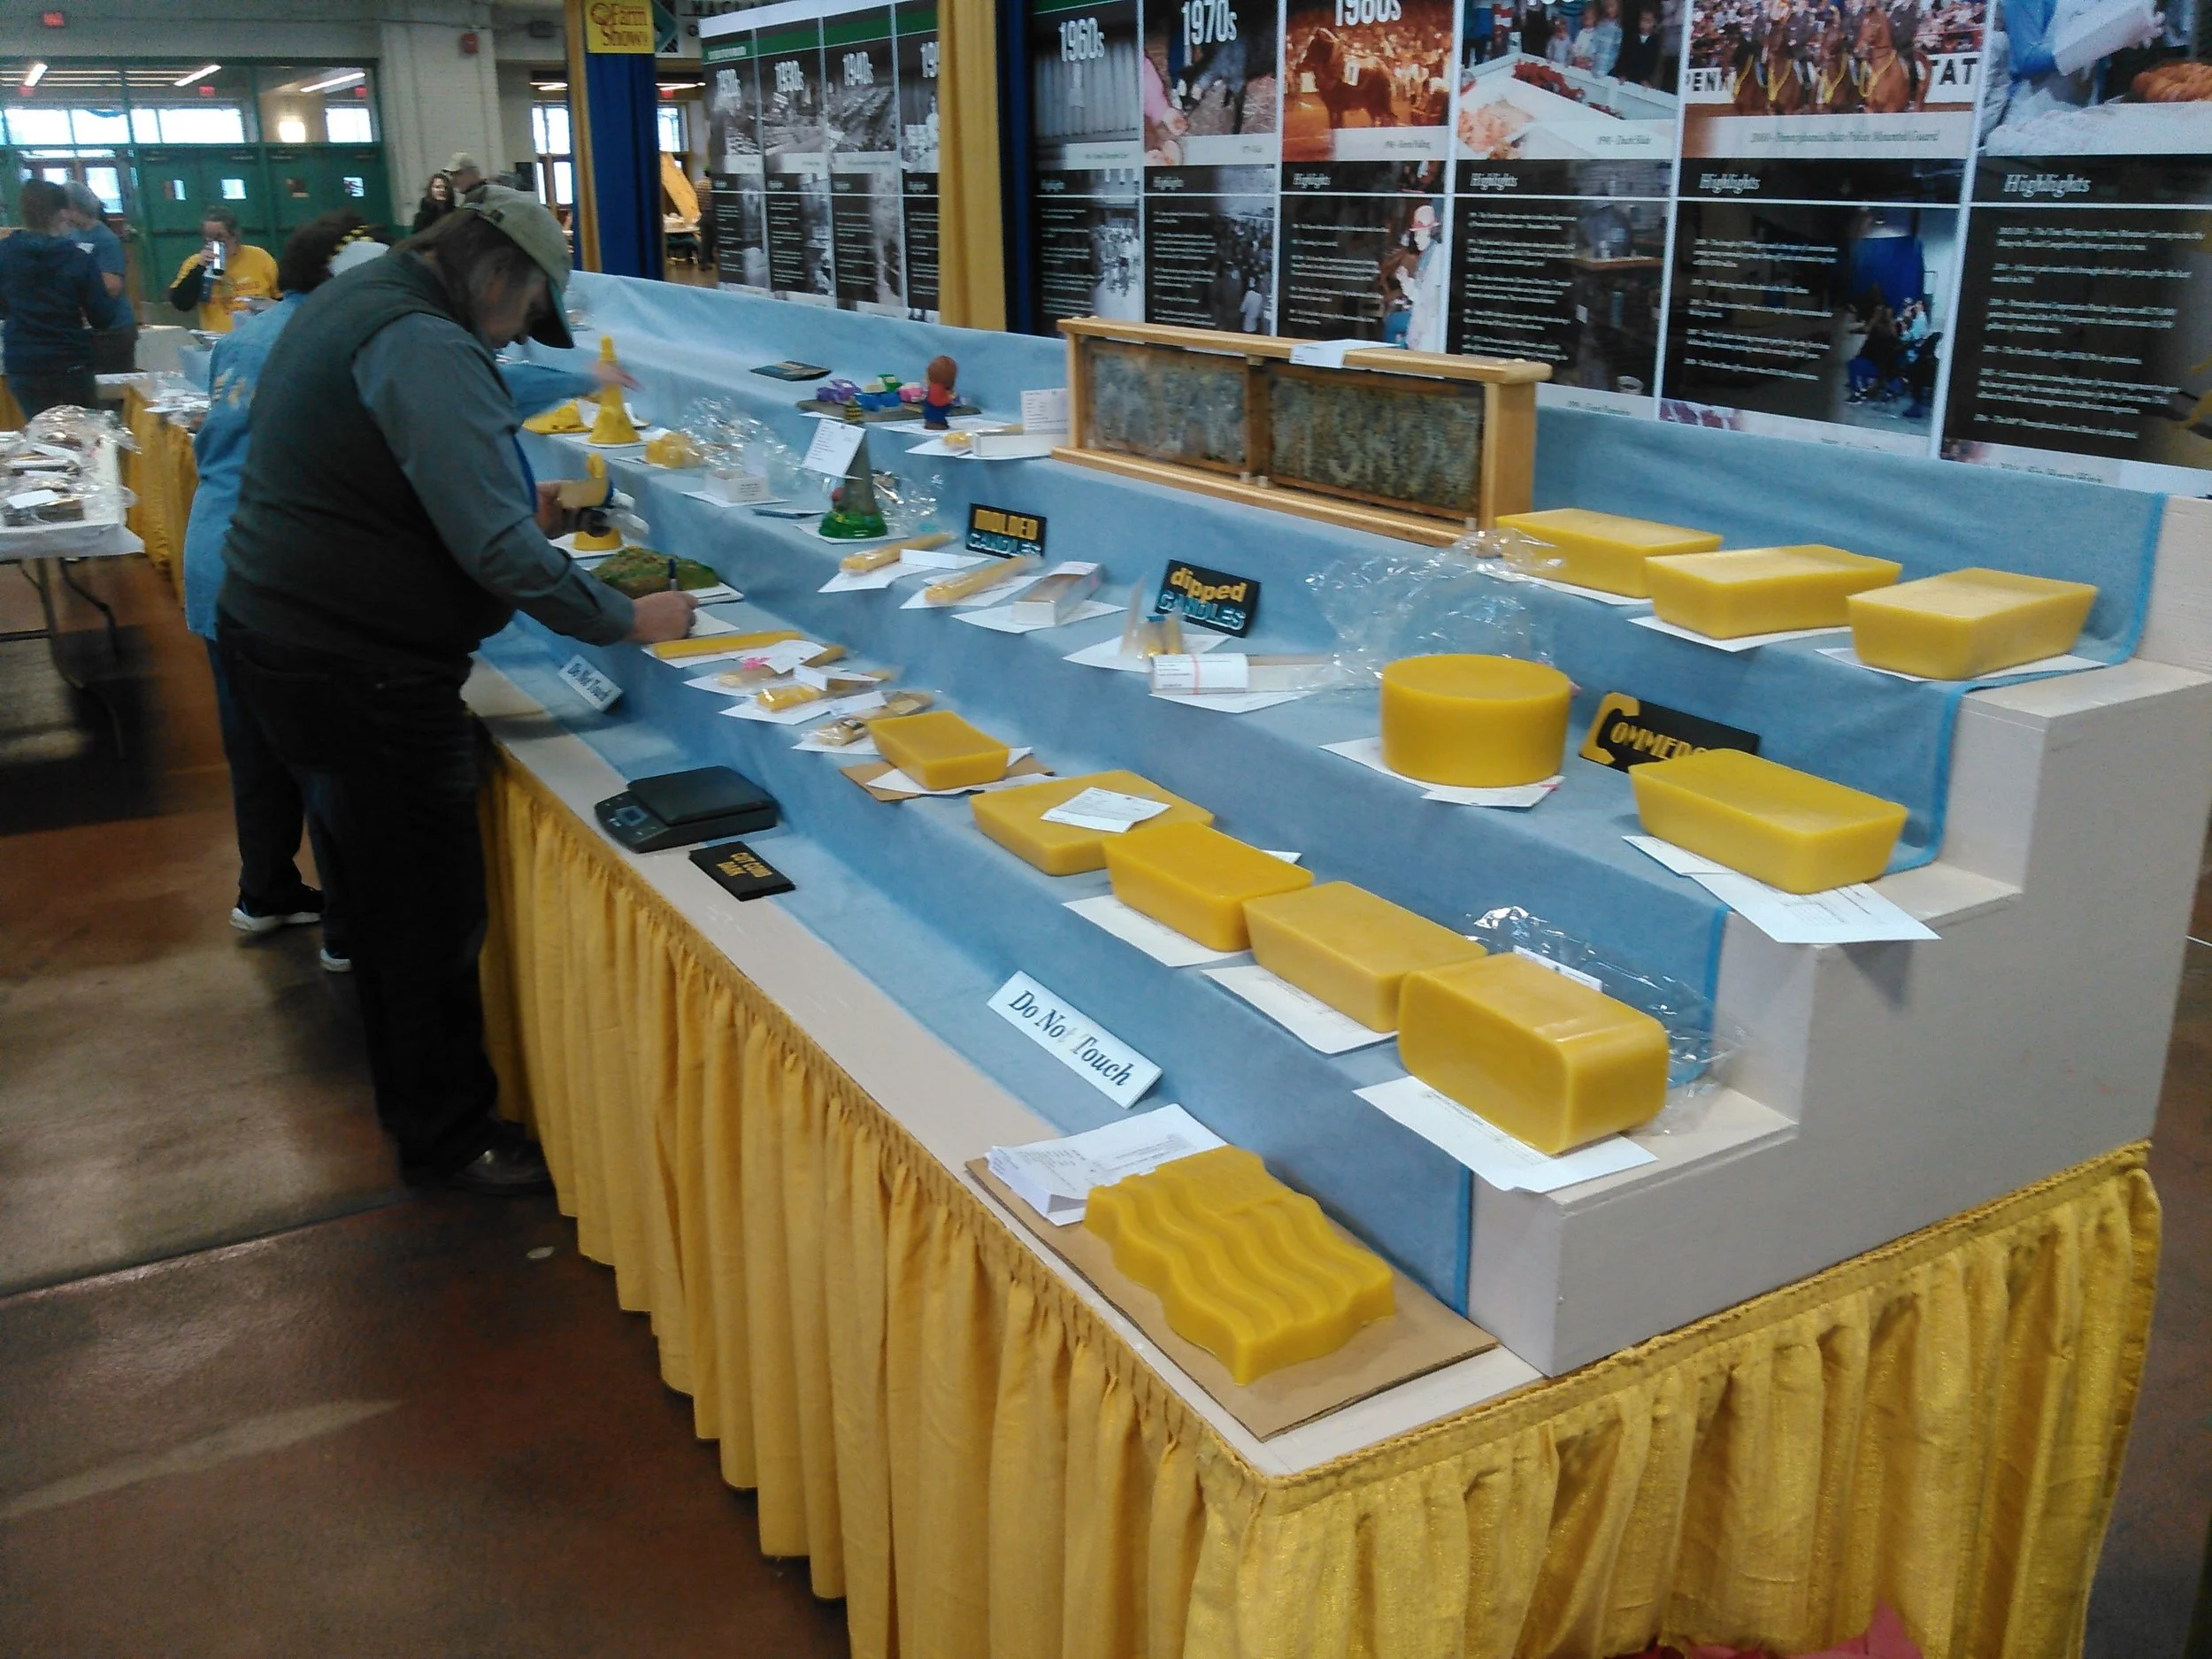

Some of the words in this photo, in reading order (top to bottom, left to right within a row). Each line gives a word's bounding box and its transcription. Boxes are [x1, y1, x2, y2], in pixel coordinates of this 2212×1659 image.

[1058, 17, 1105, 63] 1960s
[1181, 0, 1237, 44] 1970s
[1699, 173, 1761, 194] Highlights
[2004, 173, 2092, 198] Highlights
[1171, 567, 1248, 603] dipped
[1157, 590, 1247, 631] CANDLES
[1008, 989, 1040, 1018] Do
[1033, 1008, 1078, 1044] Not
[1070, 1033, 1134, 1087] Touch
